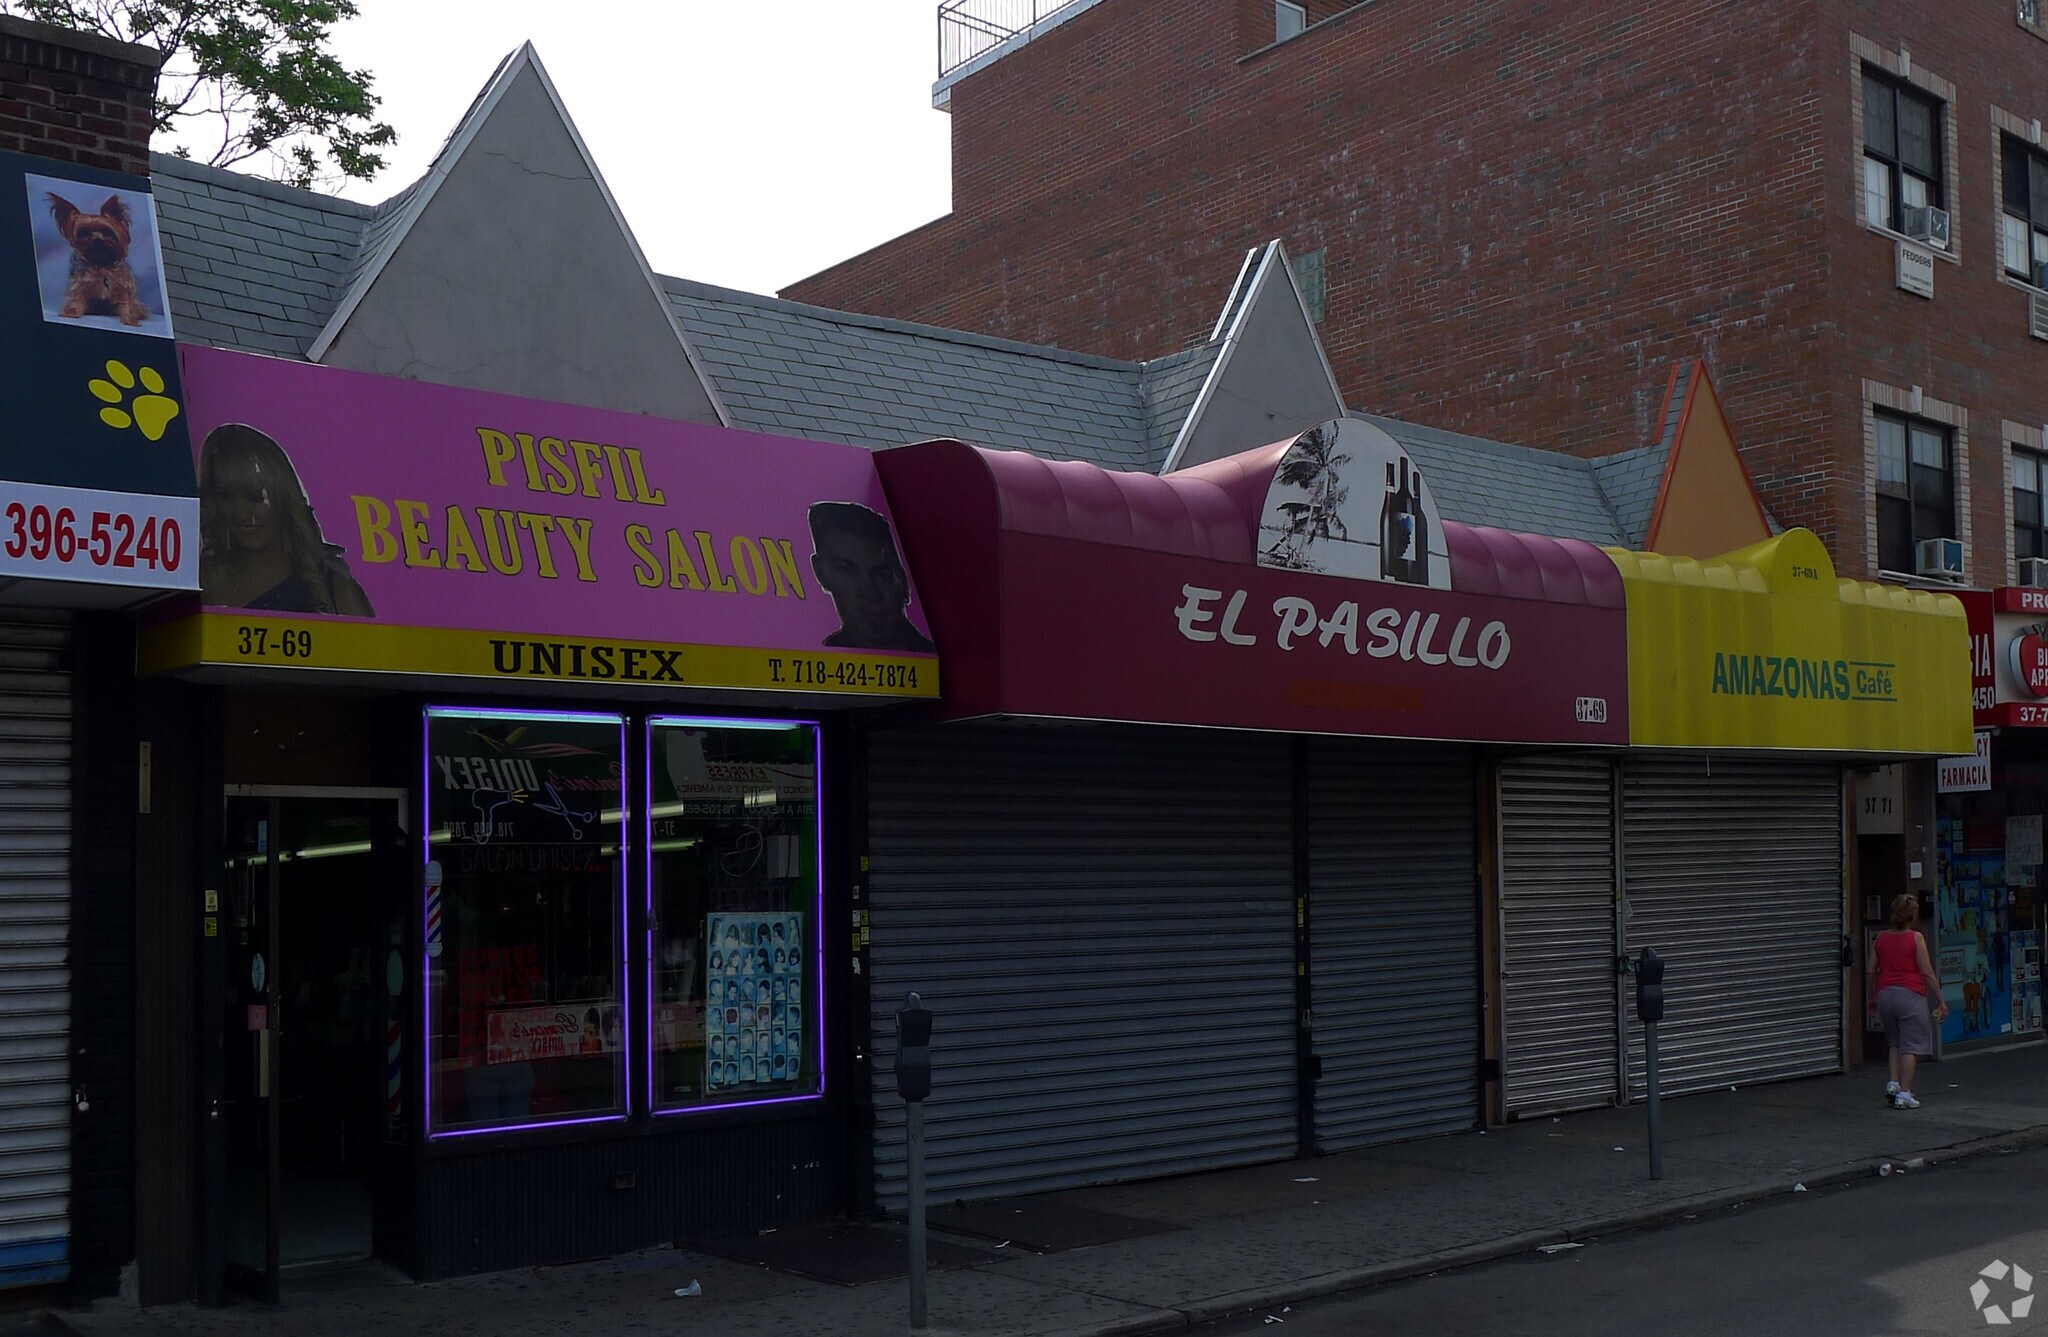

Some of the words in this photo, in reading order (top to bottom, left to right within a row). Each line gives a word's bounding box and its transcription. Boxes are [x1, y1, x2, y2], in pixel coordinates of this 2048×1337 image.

[1902, 249, 1932, 269] FEDDERS
[476, 427, 666, 506] PISFIL
[5, 502, 181, 572] 396-5240
[351, 495, 598, 582] BEAUTY
[624, 523, 806, 600] SALON
[238, 626, 312, 658] 37-69
[1173, 583, 1257, 646] EL
[1272, 595, 1511, 670] PASILLO
[489, 639, 685, 682] UNISEX
[1712, 652, 1850, 701] AMAZONAS
[1856, 670, 1893, 694] Café
[1576, 698, 1606, 722] 37-69
[1942, 765, 1988, 787] FARMACIA
[1865, 797, 1876, 814] 37
